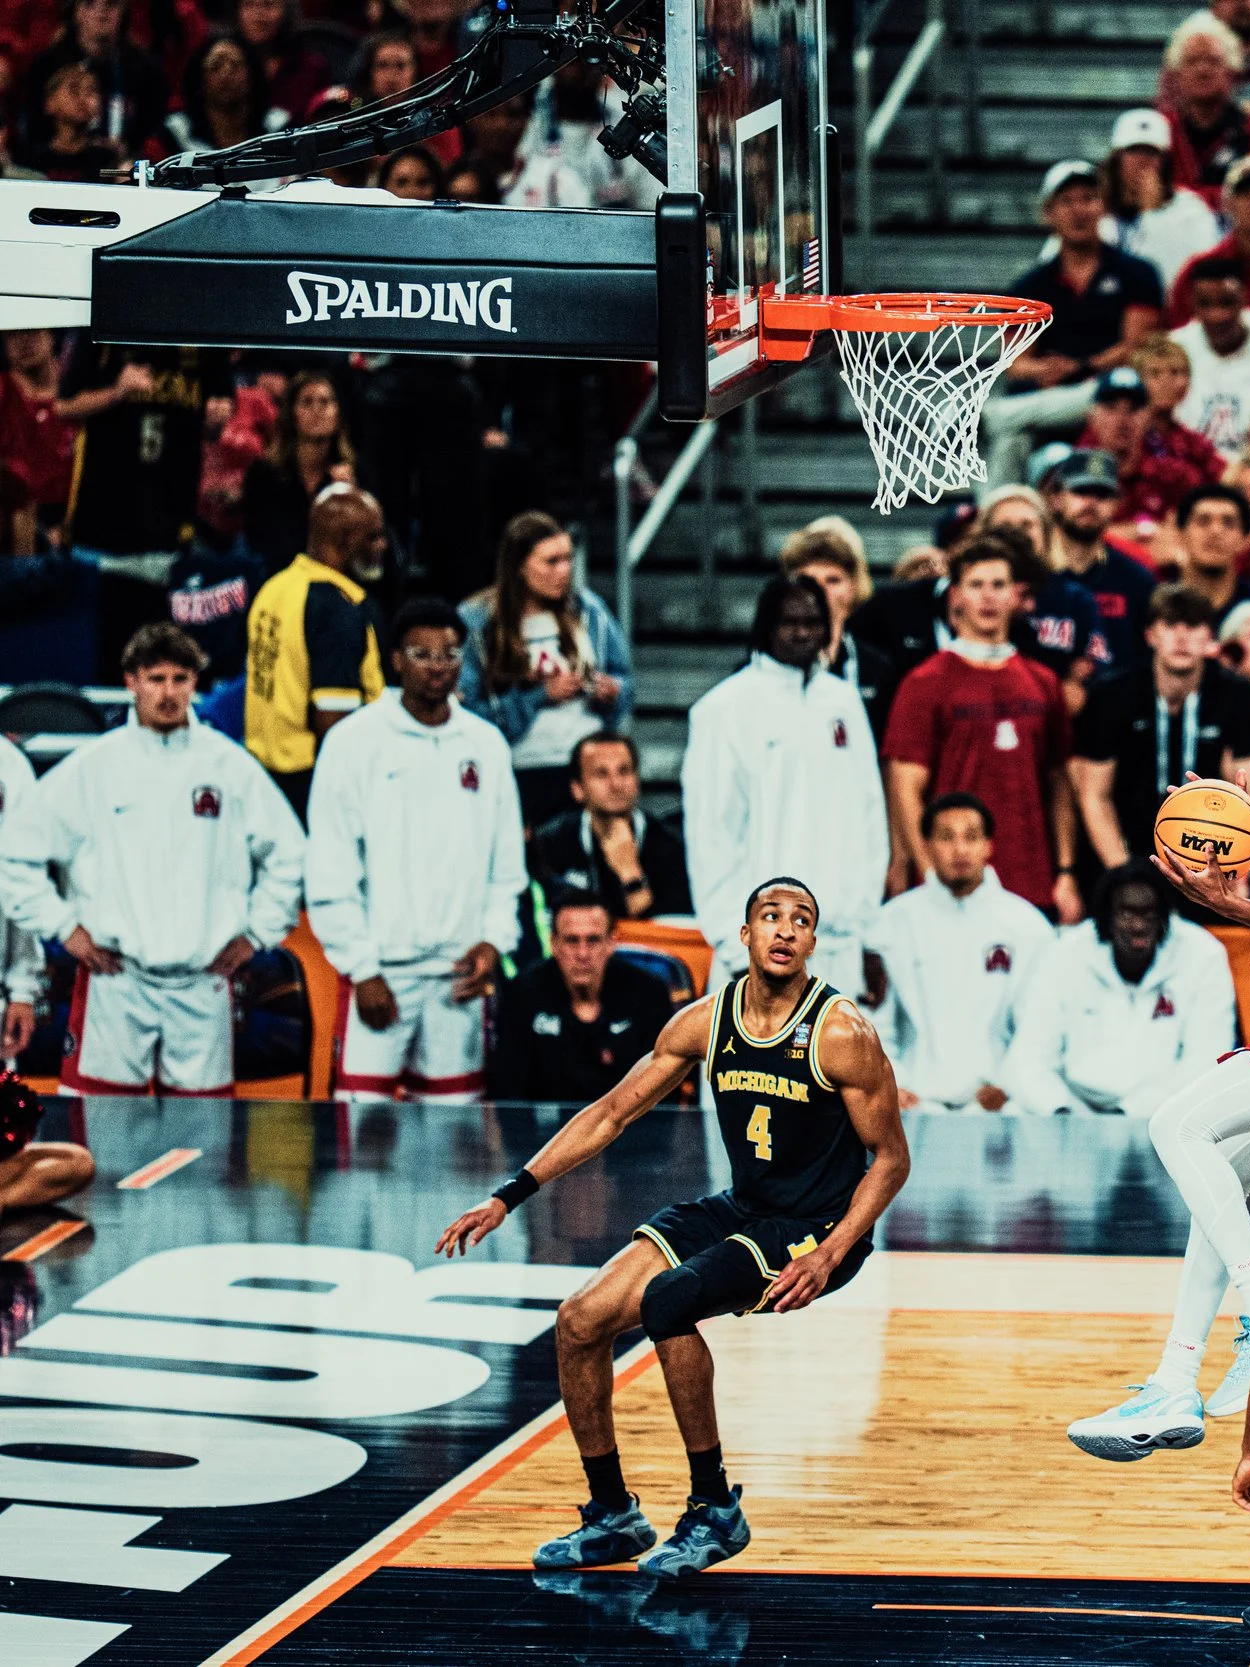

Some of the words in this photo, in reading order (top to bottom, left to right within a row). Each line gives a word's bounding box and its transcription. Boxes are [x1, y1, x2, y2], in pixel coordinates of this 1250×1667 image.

[286, 271, 517, 333] SPALDING
[717, 1070, 809, 1102] MICHIGAN
[746, 1104, 772, 1161] 4
